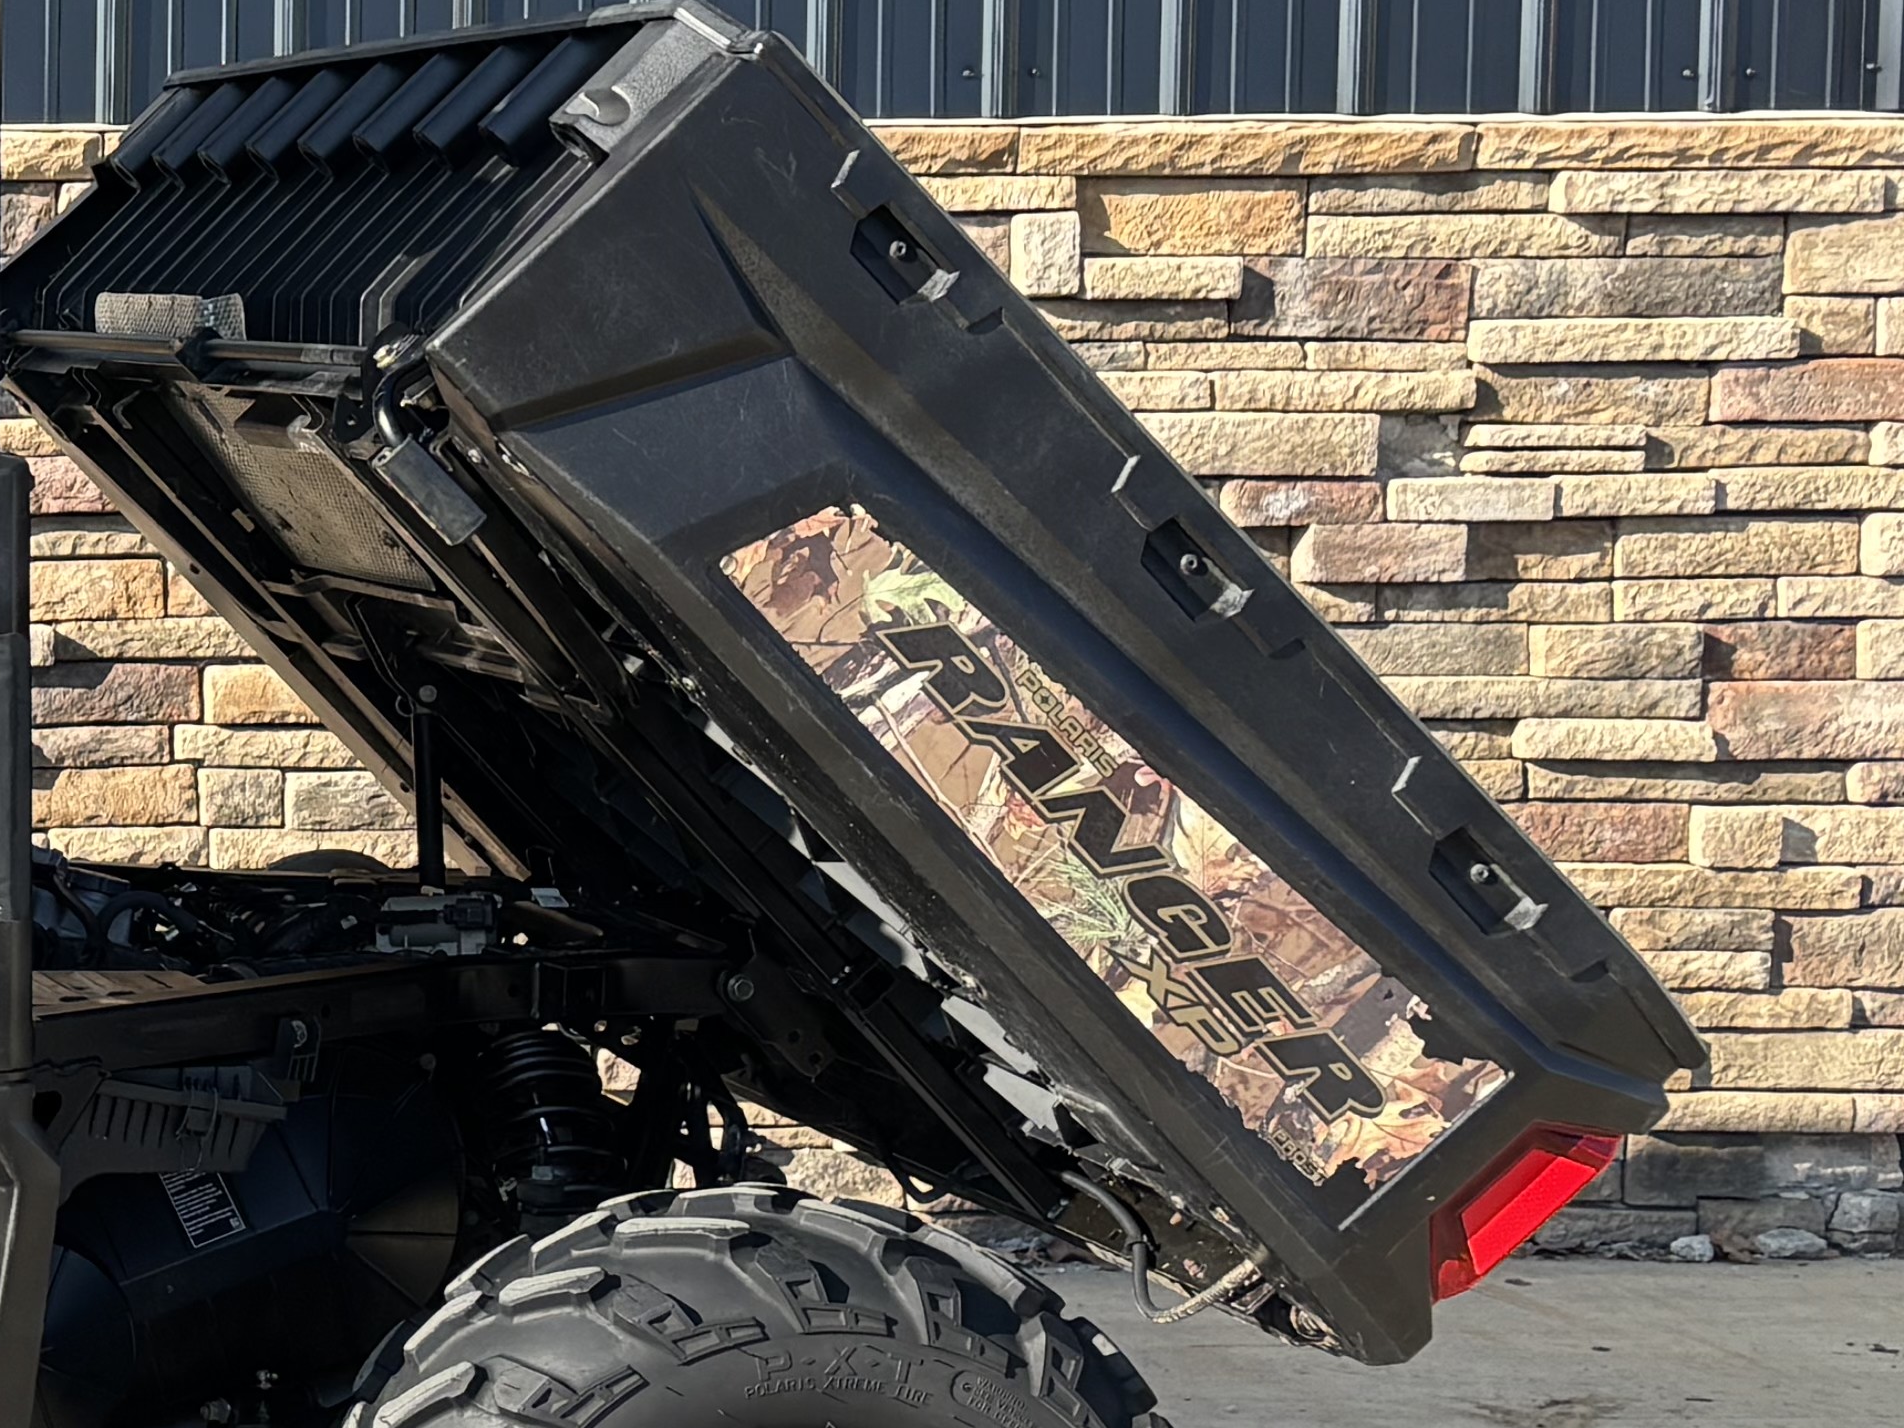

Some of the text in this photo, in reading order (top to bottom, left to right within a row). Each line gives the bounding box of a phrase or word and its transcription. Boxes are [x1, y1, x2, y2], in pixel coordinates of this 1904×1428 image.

[1016, 668, 1118, 777] POLARIS
[874, 621, 1389, 1125] RANGER
[1105, 946, 1242, 1056] XP
[743, 1376, 935, 1406] POLARIS XTREME TIRE
